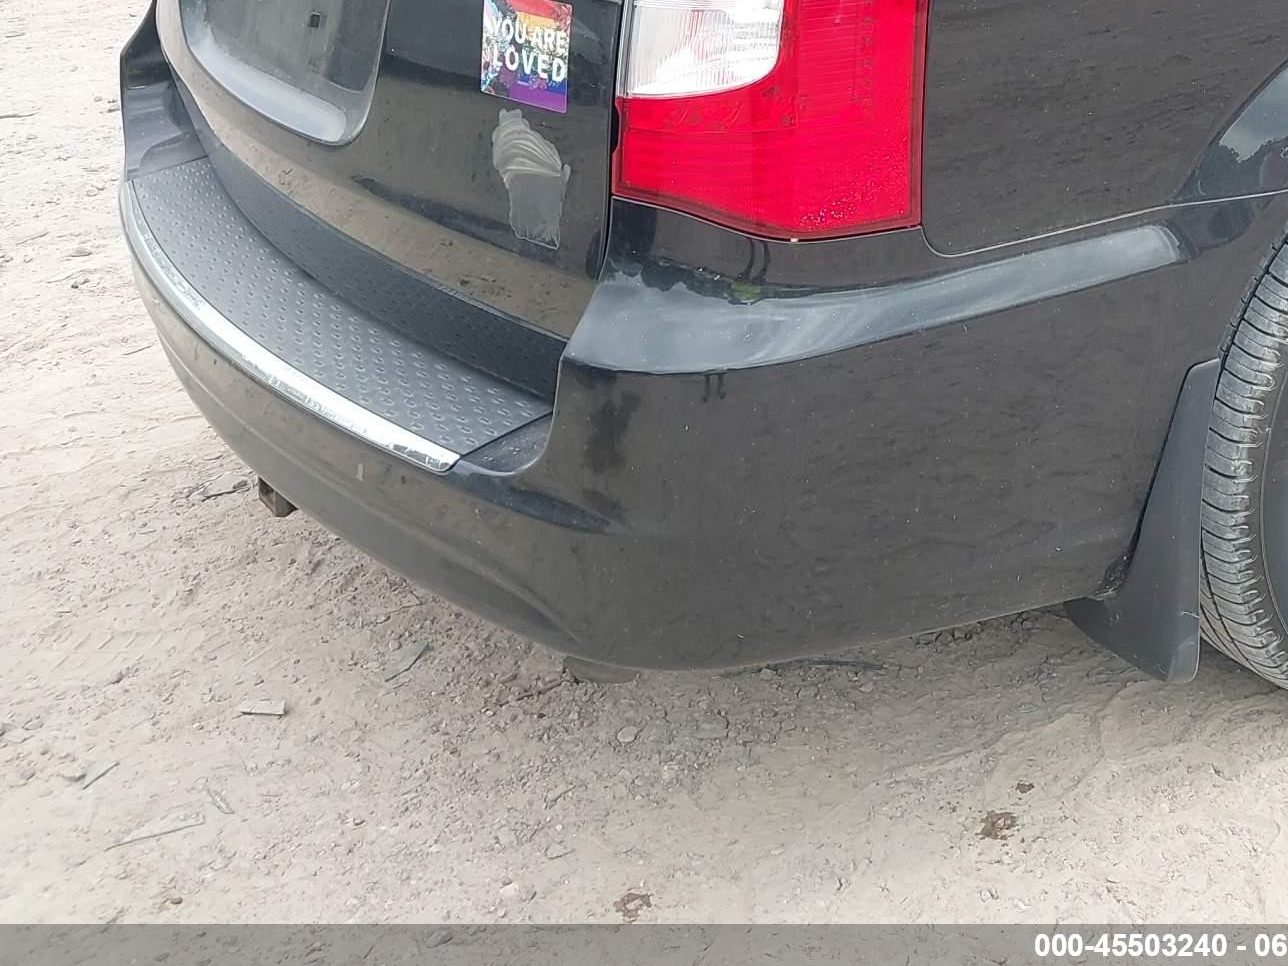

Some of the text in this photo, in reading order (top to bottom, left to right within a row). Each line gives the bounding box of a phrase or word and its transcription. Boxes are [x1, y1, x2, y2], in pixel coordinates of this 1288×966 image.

[491, 15, 567, 53] YOU ARE
[492, 44, 566, 83] LOVED
